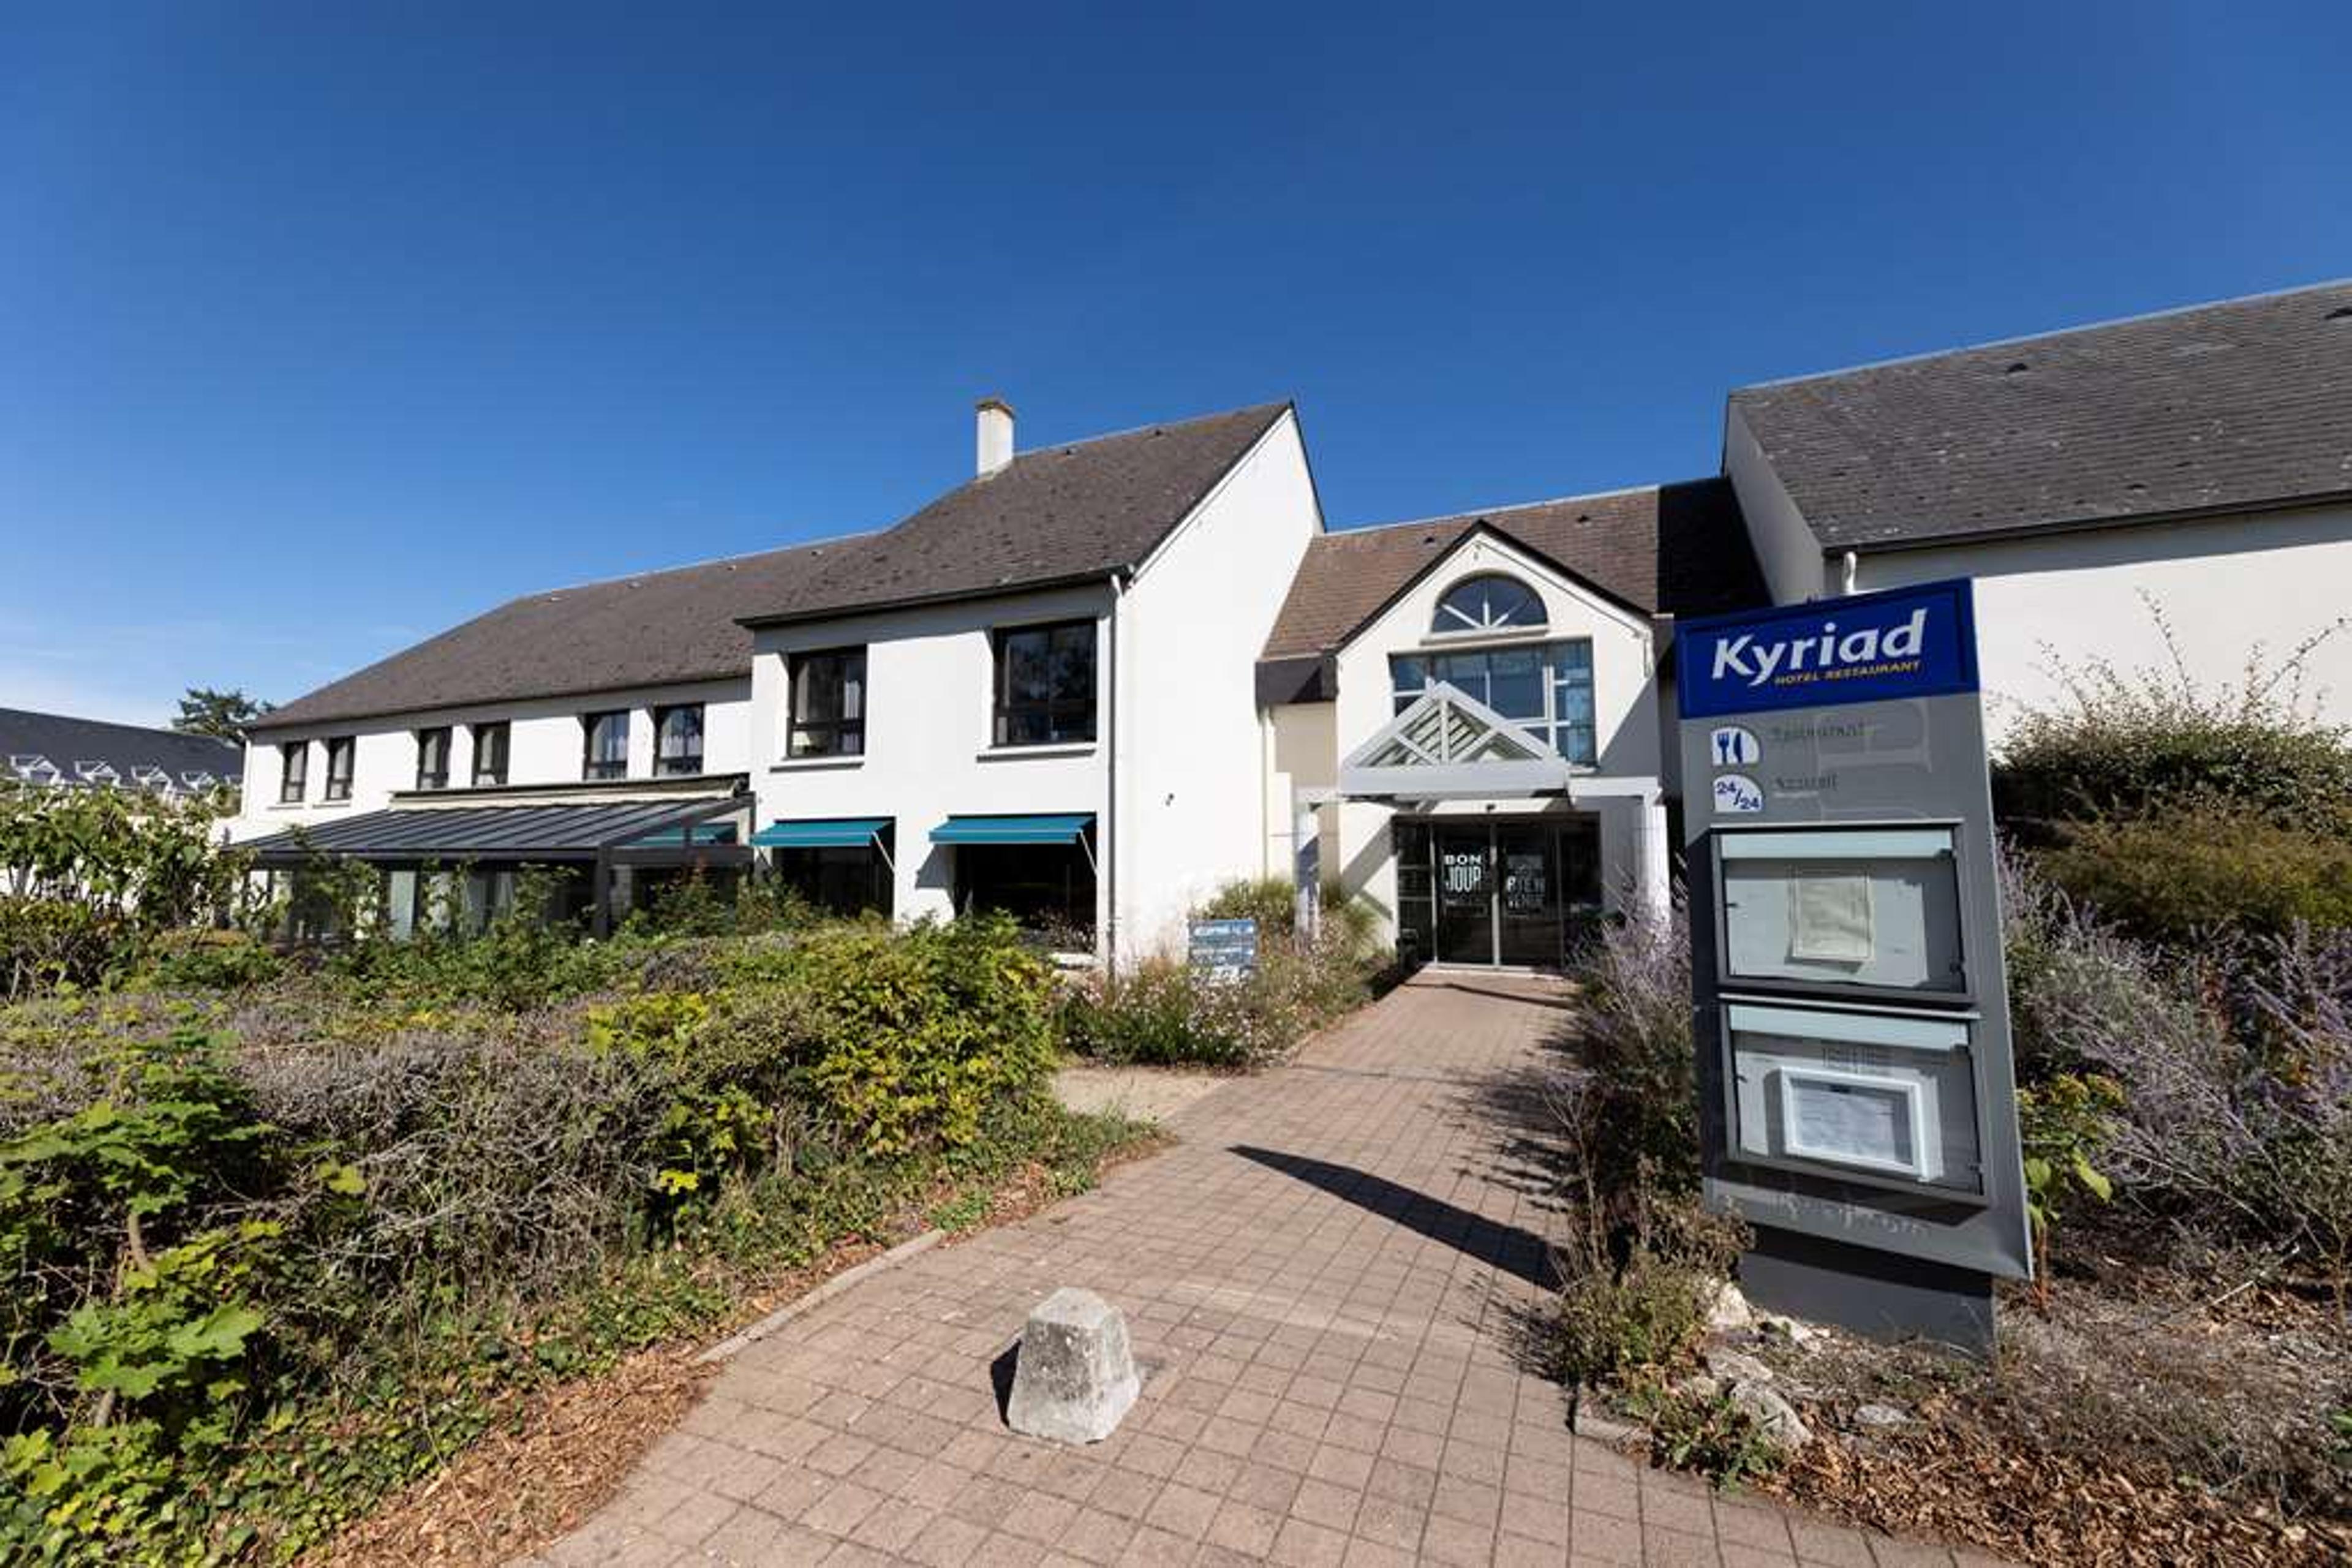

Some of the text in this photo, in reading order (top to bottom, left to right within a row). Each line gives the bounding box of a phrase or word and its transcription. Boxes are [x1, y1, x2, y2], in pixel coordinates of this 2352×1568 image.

[1712, 609, 1927, 686] Kyriad
[1774, 660, 1921, 684] HOTEL RESTAURANT
[1444, 854, 1482, 865] BON
